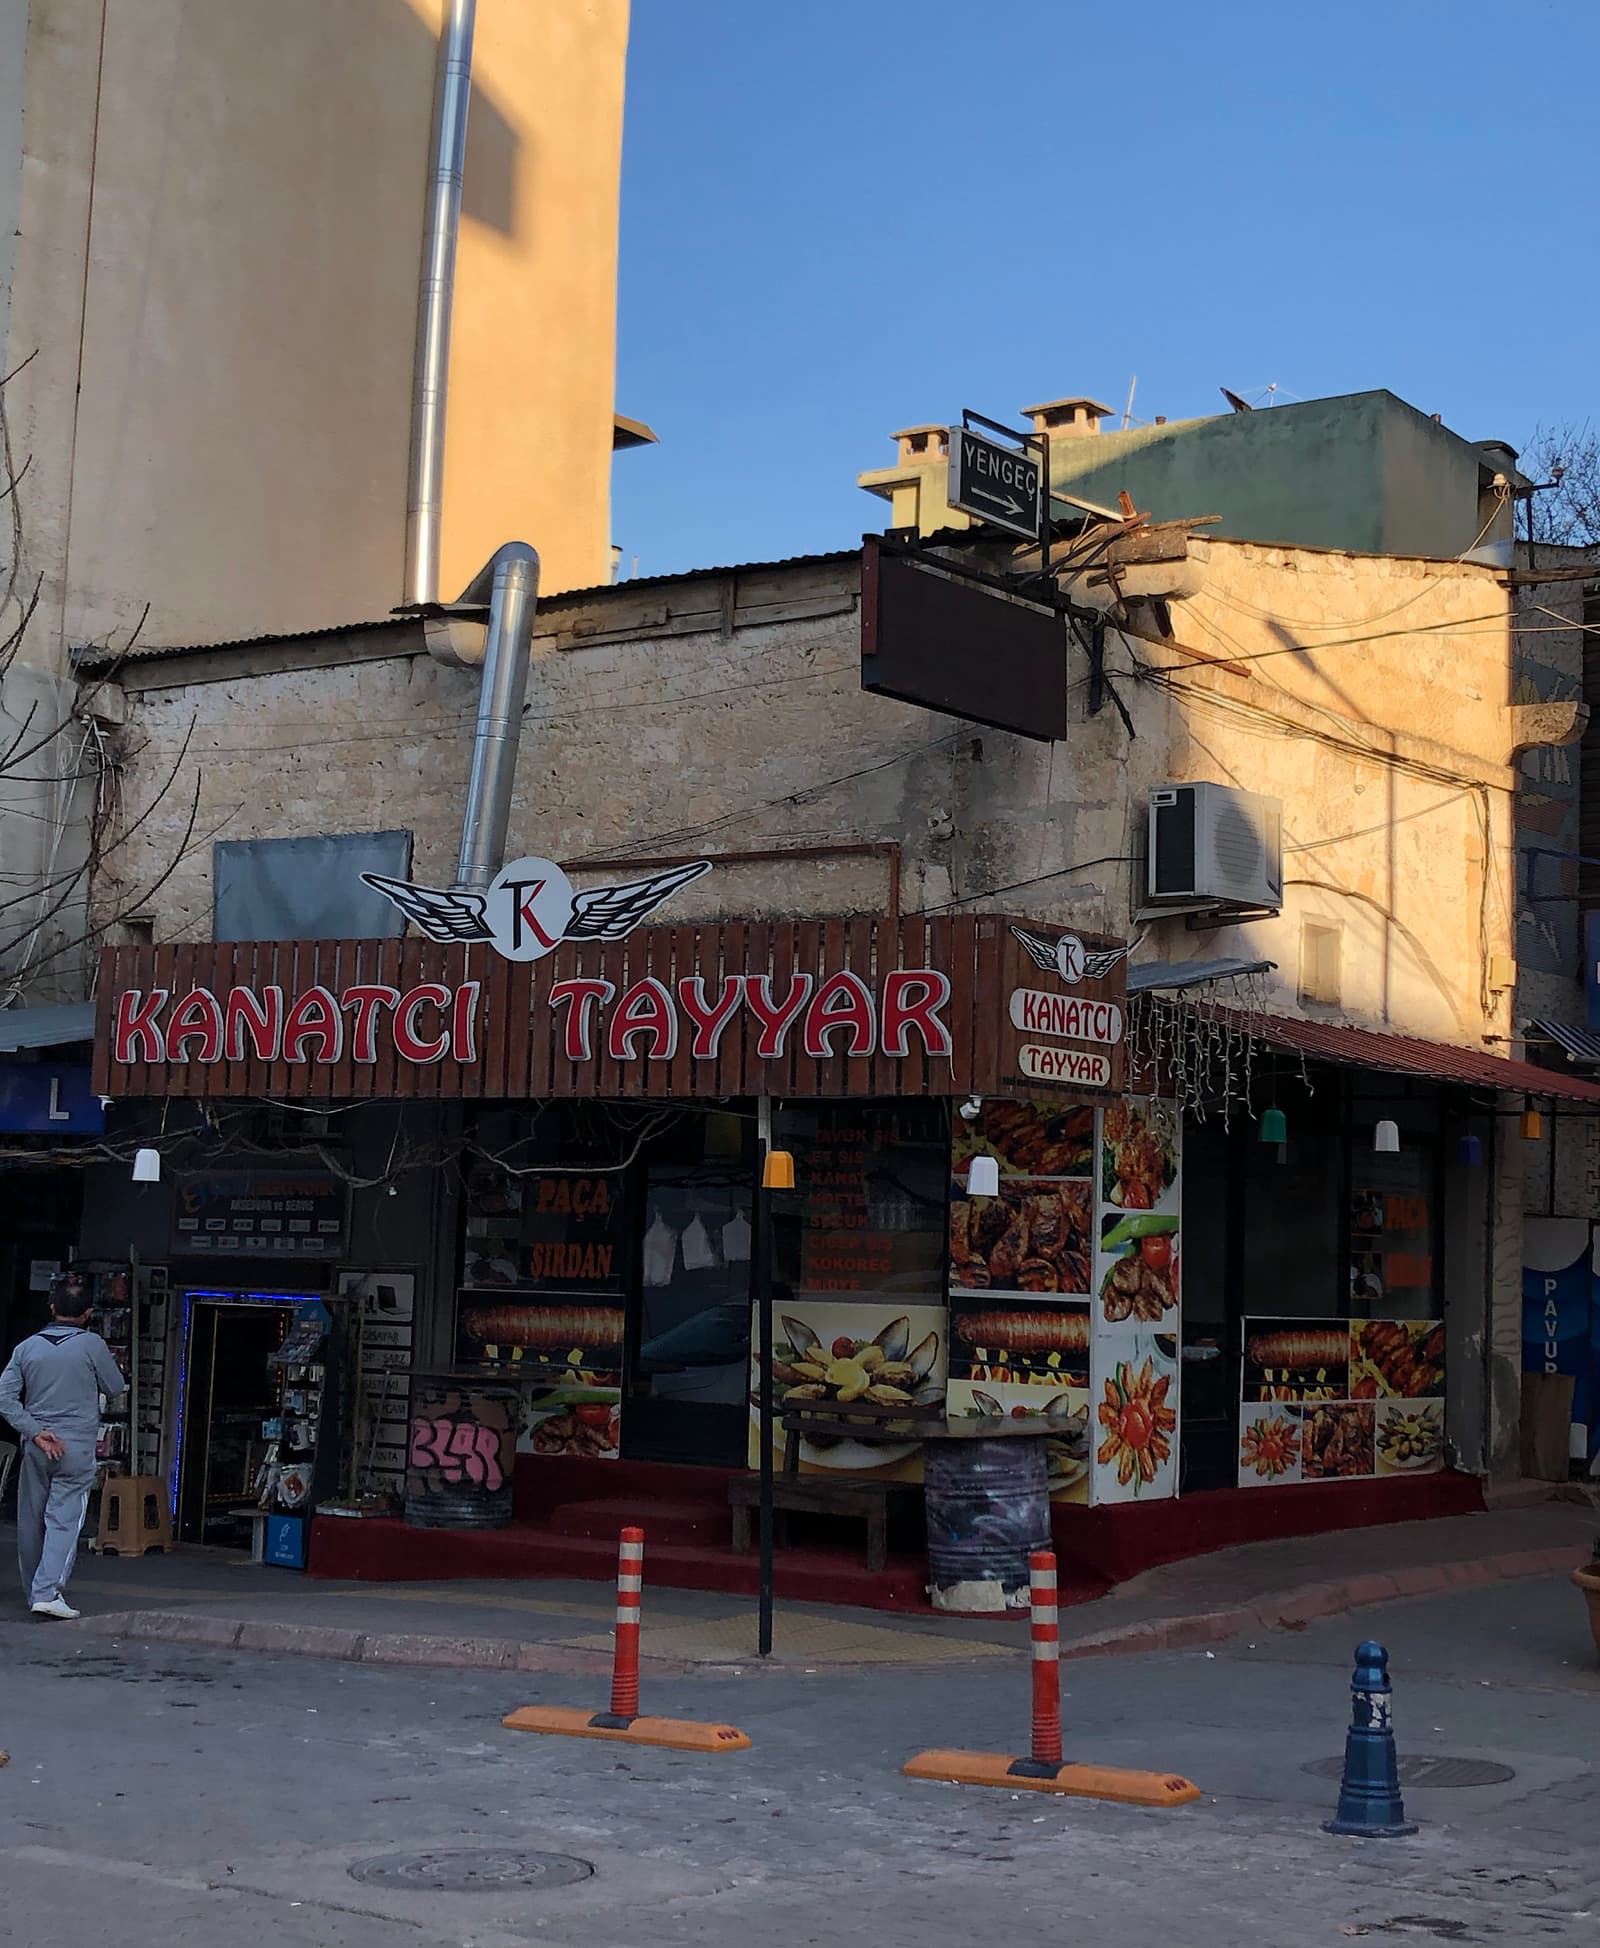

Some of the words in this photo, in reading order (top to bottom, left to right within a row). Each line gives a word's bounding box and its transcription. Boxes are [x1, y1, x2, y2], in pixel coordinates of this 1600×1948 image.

[964, 441, 1036, 502] YENGEÇ
[114, 980, 481, 1064] KANATCI
[548, 970, 953, 1061] TAYYAR
[1023, 992, 1113, 1041] KANATCI
[1028, 1048, 1104, 1082] TAYYAR
[537, 1178, 609, 1222] PAÇA
